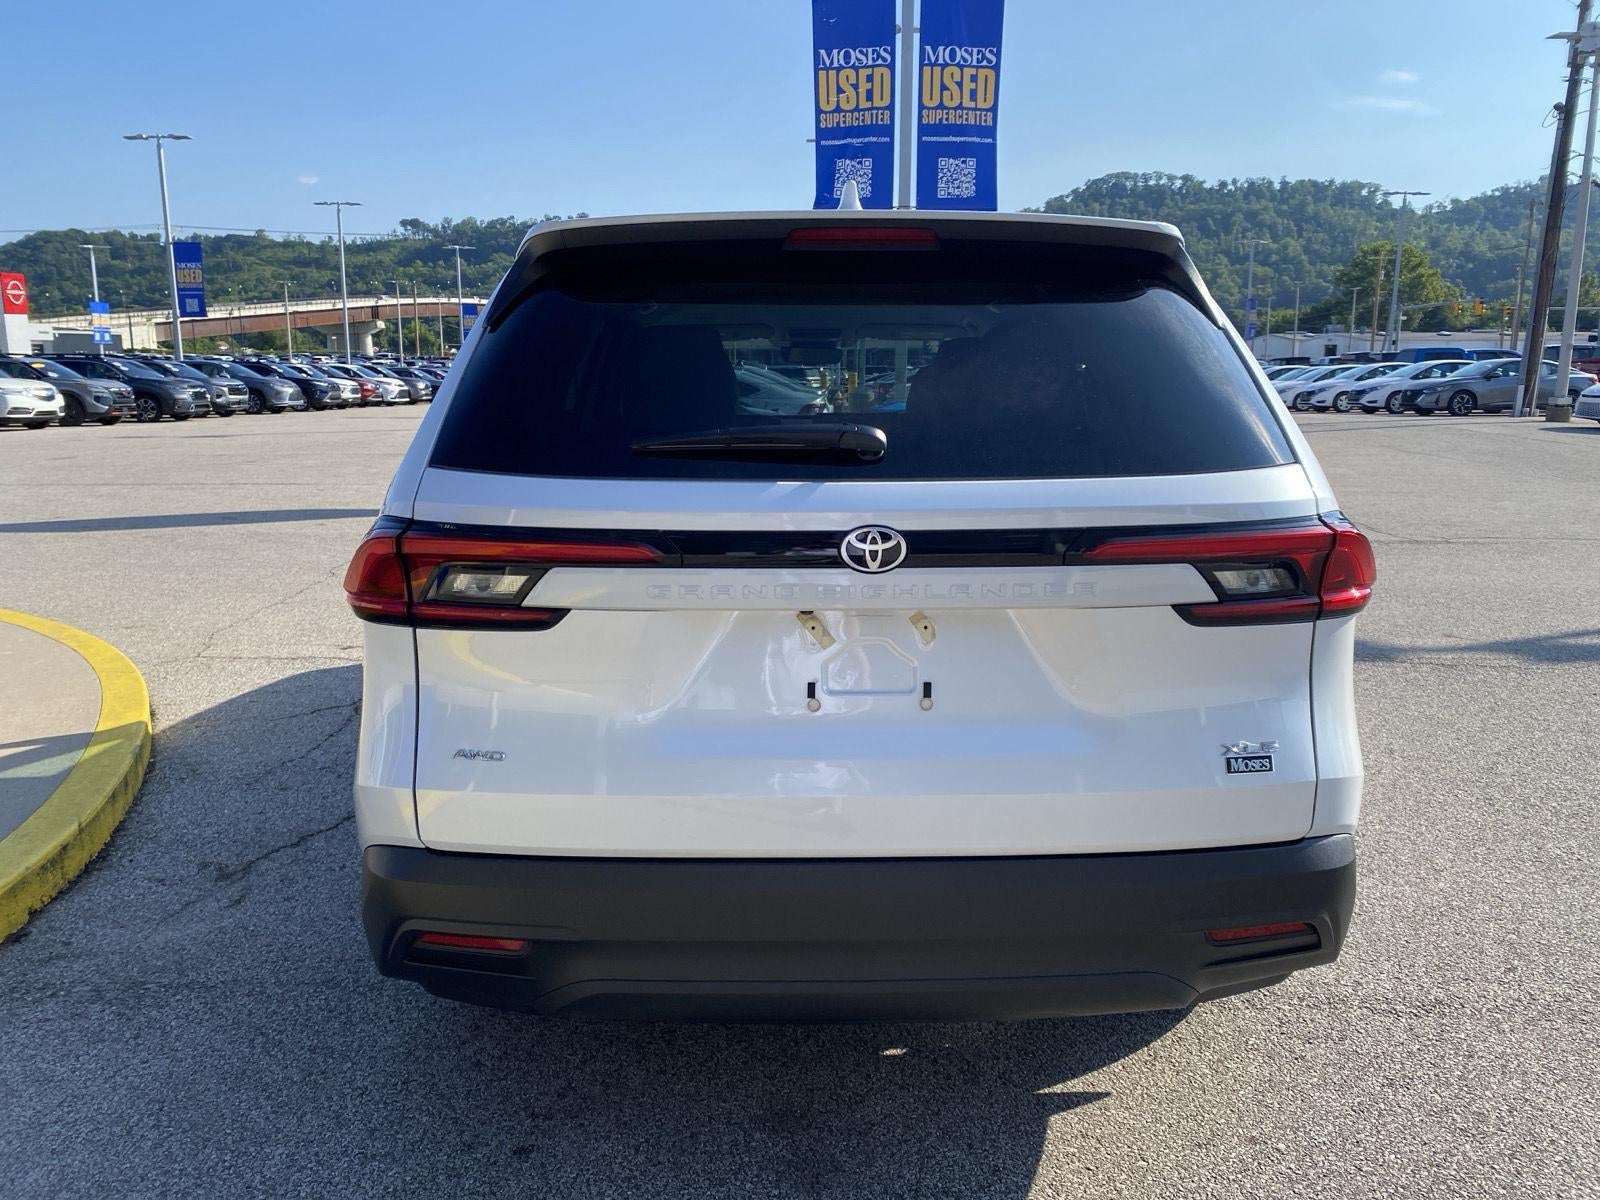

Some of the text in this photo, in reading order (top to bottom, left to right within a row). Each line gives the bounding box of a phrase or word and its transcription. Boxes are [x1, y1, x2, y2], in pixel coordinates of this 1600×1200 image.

[818, 46, 891, 68] MOSES
[923, 45, 997, 66] MOSES
[818, 66, 891, 111] USED
[922, 66, 996, 109] USED
[820, 110, 891, 128] SUPERCENTER
[922, 109, 993, 126] SUPERCENTER
[922, 135, 993, 143] mosesusedsupercenter.com
[176, 269, 203, 283] USED
[646, 582, 1098, 601] GRAND HIGHLANDER
[453, 748, 507, 761] AWD
[1229, 758, 1271, 772] MOSES
